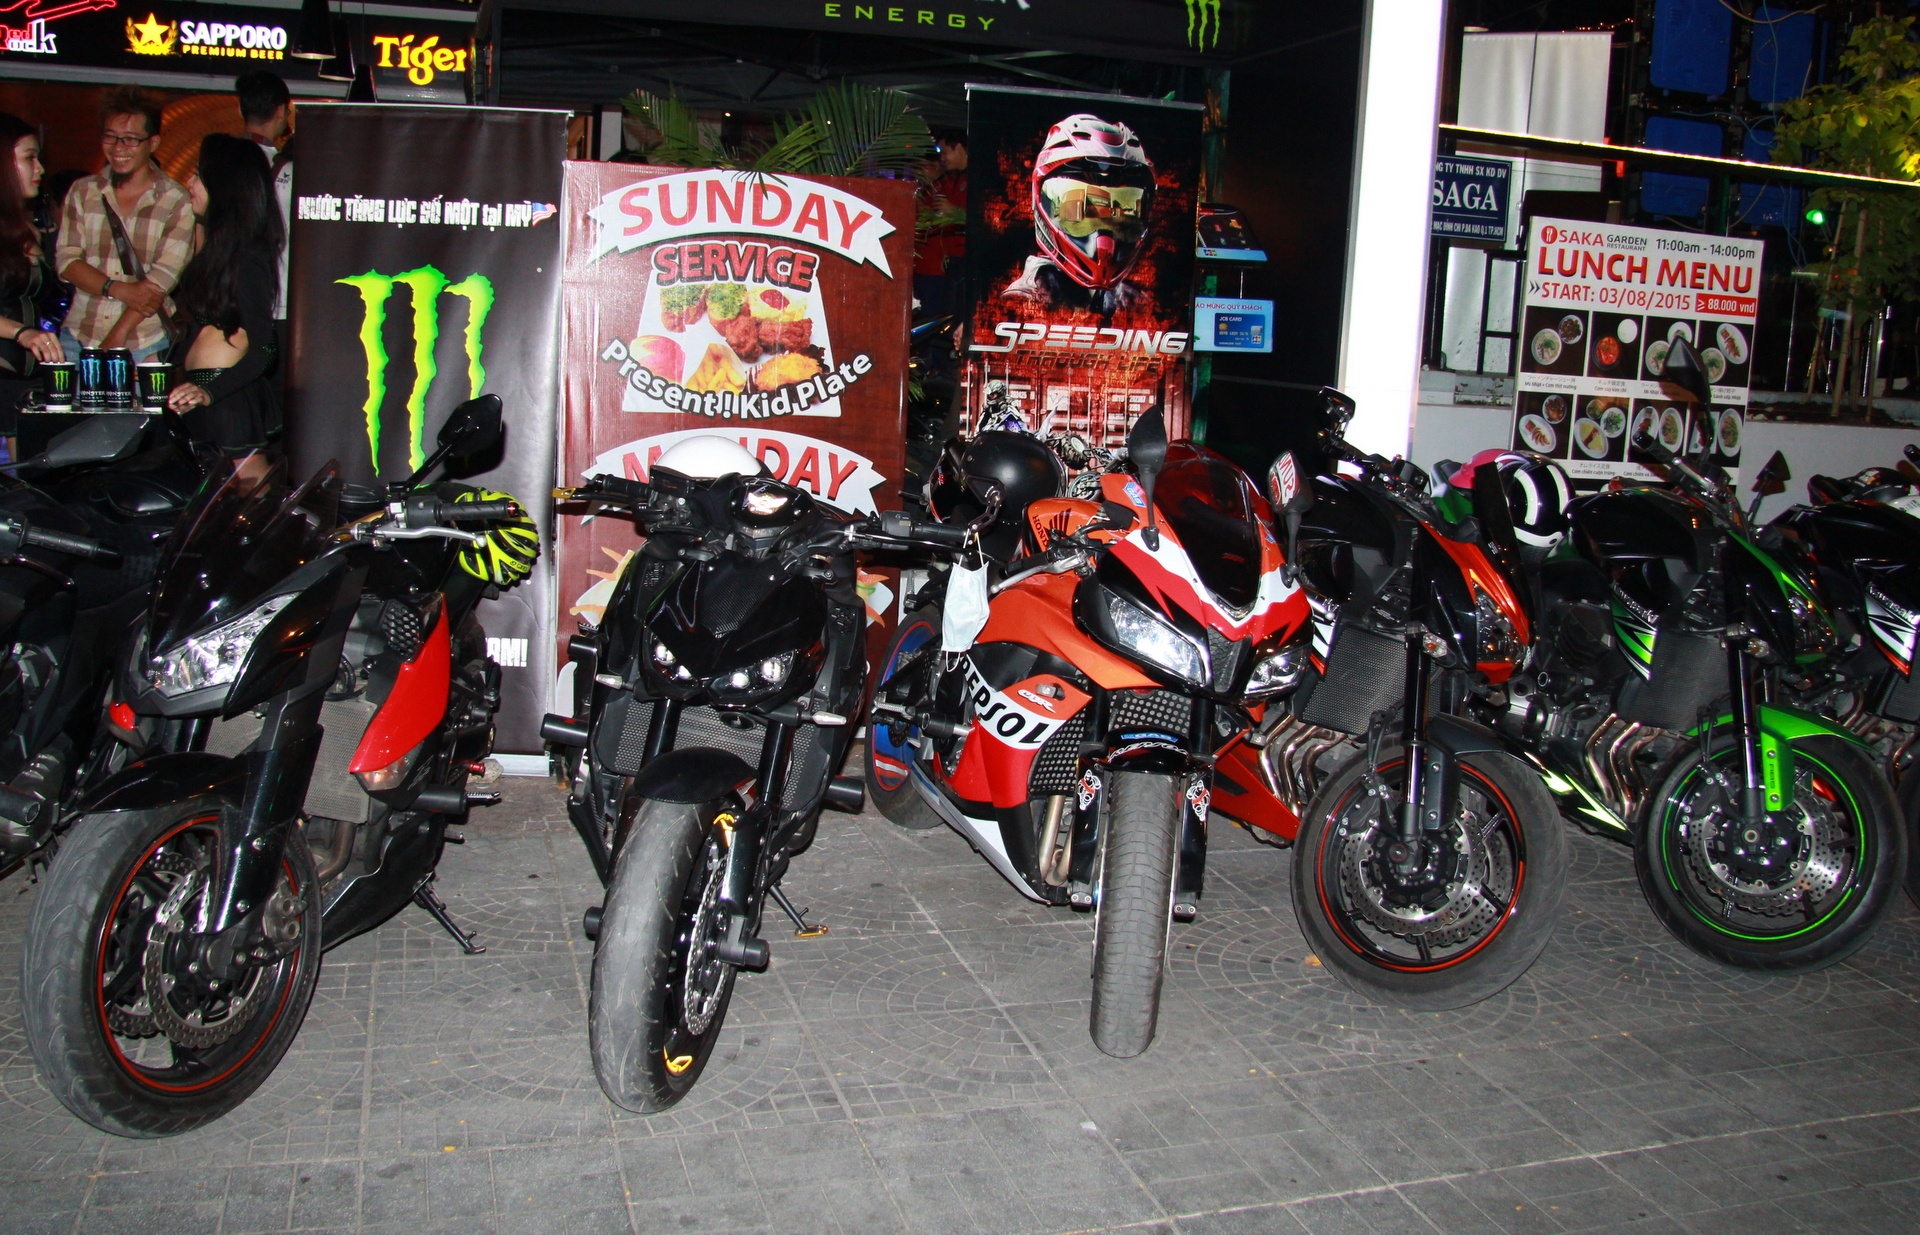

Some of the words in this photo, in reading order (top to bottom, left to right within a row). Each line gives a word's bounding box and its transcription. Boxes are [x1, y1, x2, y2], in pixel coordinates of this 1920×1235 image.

[825, 3, 995, 31] ENERGY
[180, 20, 287, 50] SAPPORO
[182, 45, 246, 58] PREMIUM
[250, 48, 284, 60] BEER
[373, 34, 466, 85] Tiger
[1445, 162, 1454, 173] TY
[1455, 163, 1474, 175] TNHH
[1475, 165, 1484, 177] SX
[1485, 166, 1495, 178] KD
[1497, 168, 1507, 179] DV
[1432, 179, 1498, 211] SAGA
[298, 194, 341, 221] NƯỚC
[344, 195, 386, 222] TĂNG
[388, 198, 417, 229] LỰC
[420, 194, 443, 225] SỐ
[444, 198, 480, 231] MỘT
[482, 203, 502, 232] tại
[618, 179, 873, 250] SUNDAY
[1606, 234, 1647, 246] GARDEN
[1606, 243, 1646, 252] RESTAURANT
[1655, 238, 1700, 254] 11:00am
[1710, 244, 1755, 261] 14:00pm
[653, 243, 818, 291] SERVICE
[1537, 246, 1648, 284] LUNCH
[1656, 258, 1753, 294] MENU
[1541, 282, 1595, 302] START:
[1599, 287, 1691, 311] 03/08/2015
[1707, 299, 1737, 312] 88.000
[1739, 301, 1755, 313] vnd
[968, 322, 1189, 354] SPEEDING
[1016, 350, 1112, 369] THROUGH
[1117, 354, 1163, 372] LIFE
[740, 387, 793, 419] Kid
[796, 353, 872, 409] Plate
[622, 436, 860, 501] MDAY
